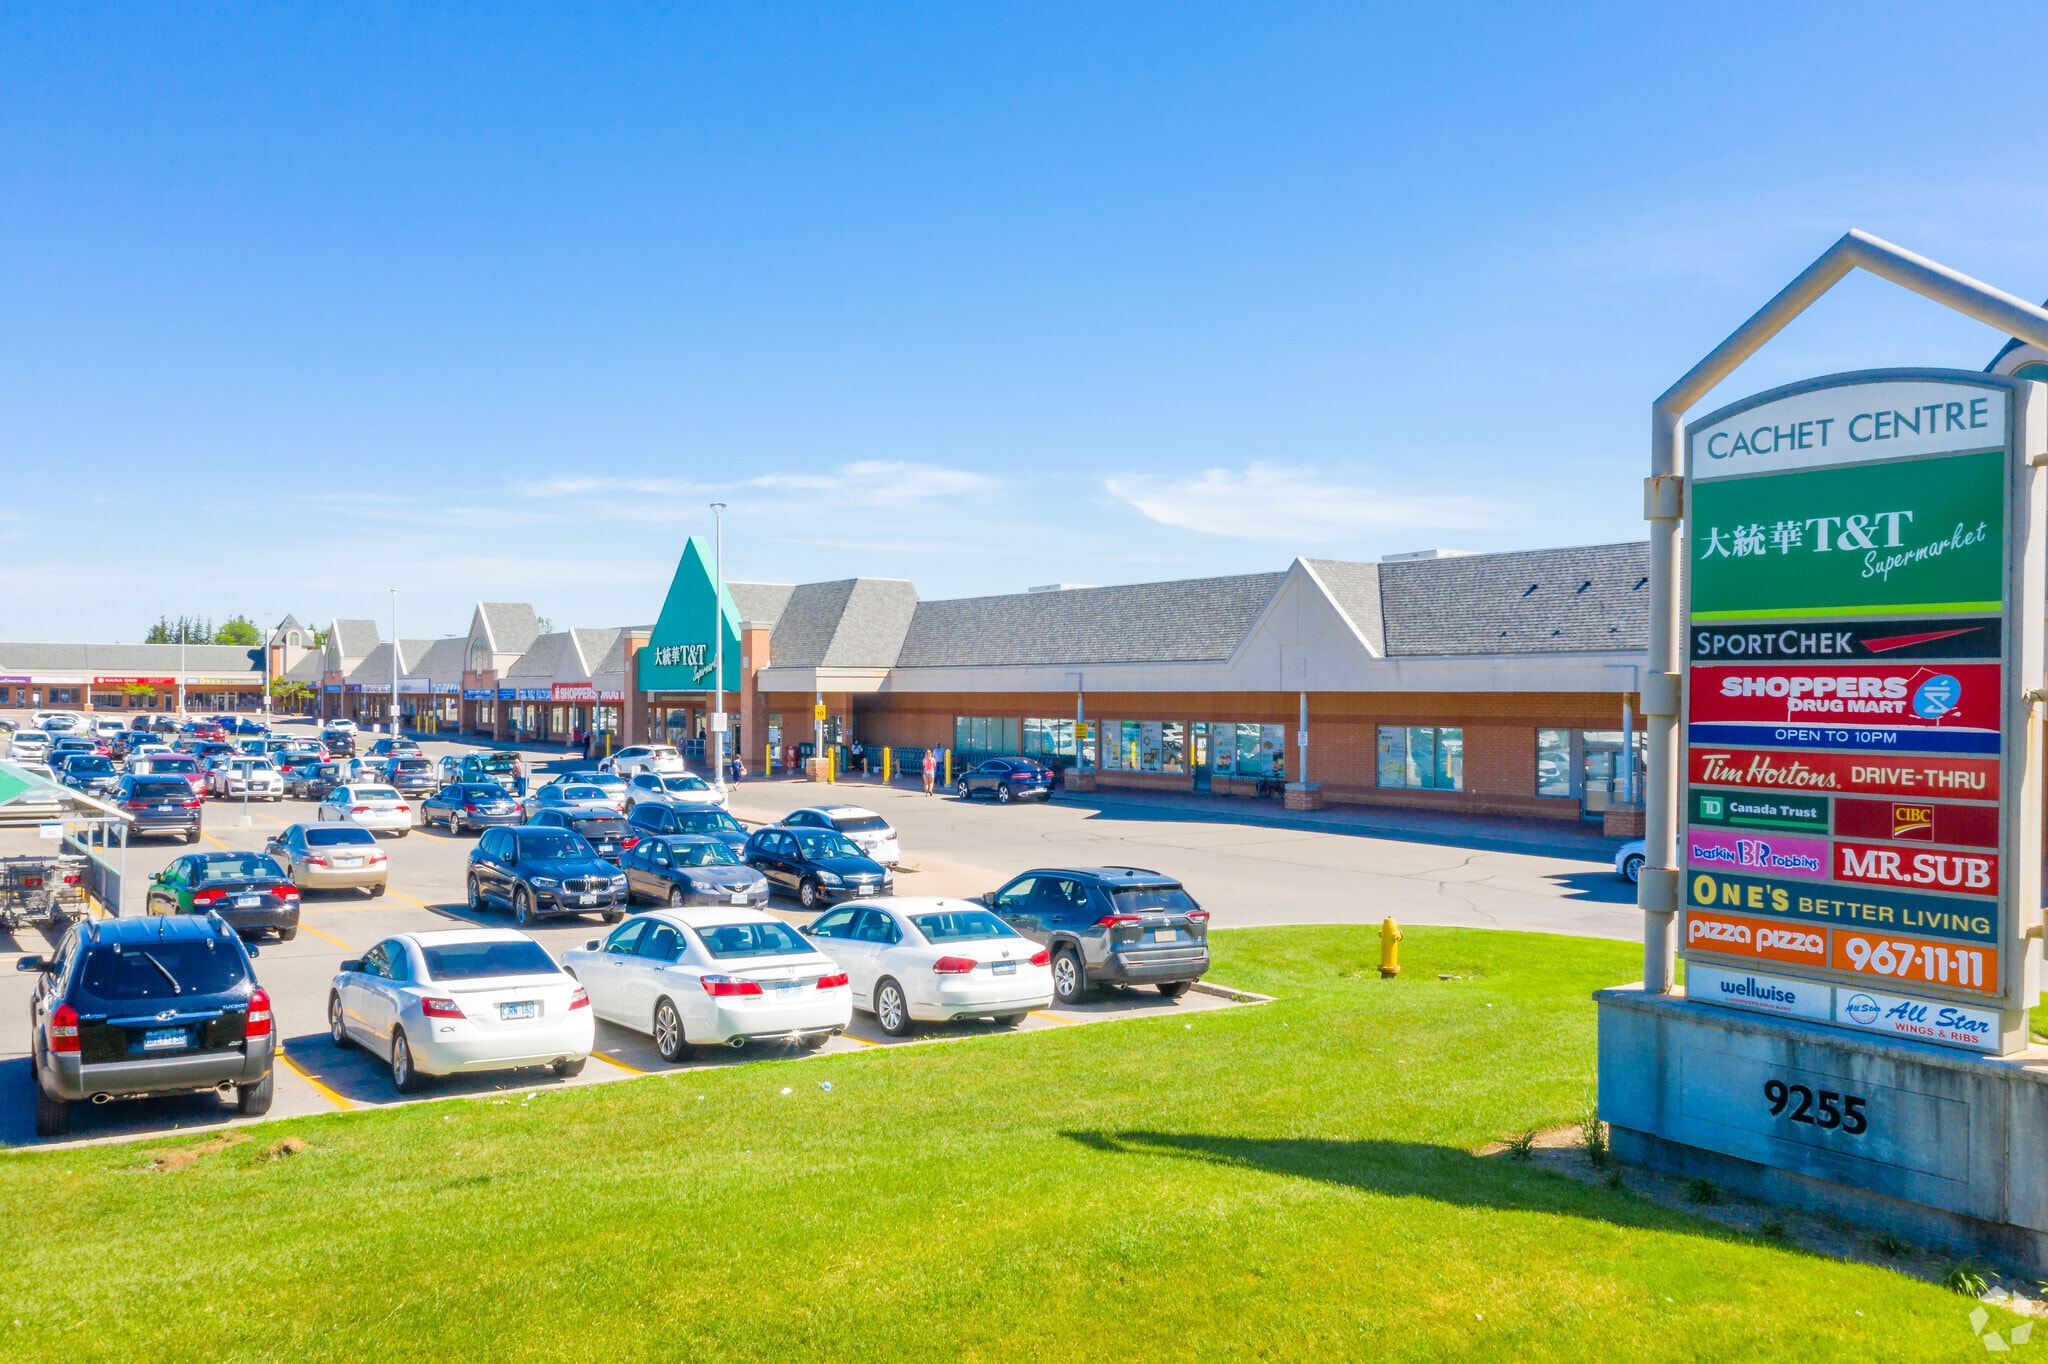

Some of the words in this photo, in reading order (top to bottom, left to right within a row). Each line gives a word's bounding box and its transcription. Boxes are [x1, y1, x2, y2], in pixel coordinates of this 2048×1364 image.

[1707, 418, 1834, 460] CACHET
[1849, 397, 1989, 443] CENTRE
[1700, 521, 1803, 560] 大統華
[1805, 510, 1913, 553] T&T
[1861, 521, 1988, 582] Supermarket
[680, 644, 706, 666] T&T
[560, 687, 597, 700] SHOPPERS
[600, 690, 619, 700] RUG
[1719, 676, 1908, 699] SHOPPERS
[1788, 699, 1844, 712] DRUG
[1848, 700, 1907, 714] MART
[1775, 729, 1821, 741] OPEN
[1825, 730, 1849, 742] TO
[1855, 731, 1897, 744] 10PM
[1702, 754, 1744, 783] Tim
[1746, 754, 1837, 788] Hortons
[1851, 766, 1986, 790] DRIVE-THRU
[1702, 800, 1721, 815] TD
[1729, 802, 1777, 816] Canada
[1780, 805, 1818, 818] Trust
[1895, 807, 1931, 822] CIBC
[1692, 845, 1736, 864] baskin
[1736, 839, 1771, 867] BR
[1771, 853, 1818, 872] robbins
[1693, 874, 1790, 912] ONE'S
[1799, 896, 1895, 923] BETTER
[1903, 908, 1990, 934] LIVING
[1689, 920, 1751, 944] pizza
[1756, 928, 1824, 954] pizza
[1720, 977, 1796, 1004] wellwise
[1885, 1001, 1928, 1023] All
[1935, 1007, 1990, 1033] Star
[1895, 1022, 1934, 1036] WINGS
[1938, 1029, 1946, 1038] &
[1951, 1031, 1979, 1044] RIBS
[1763, 1079, 1867, 1136] 9255
